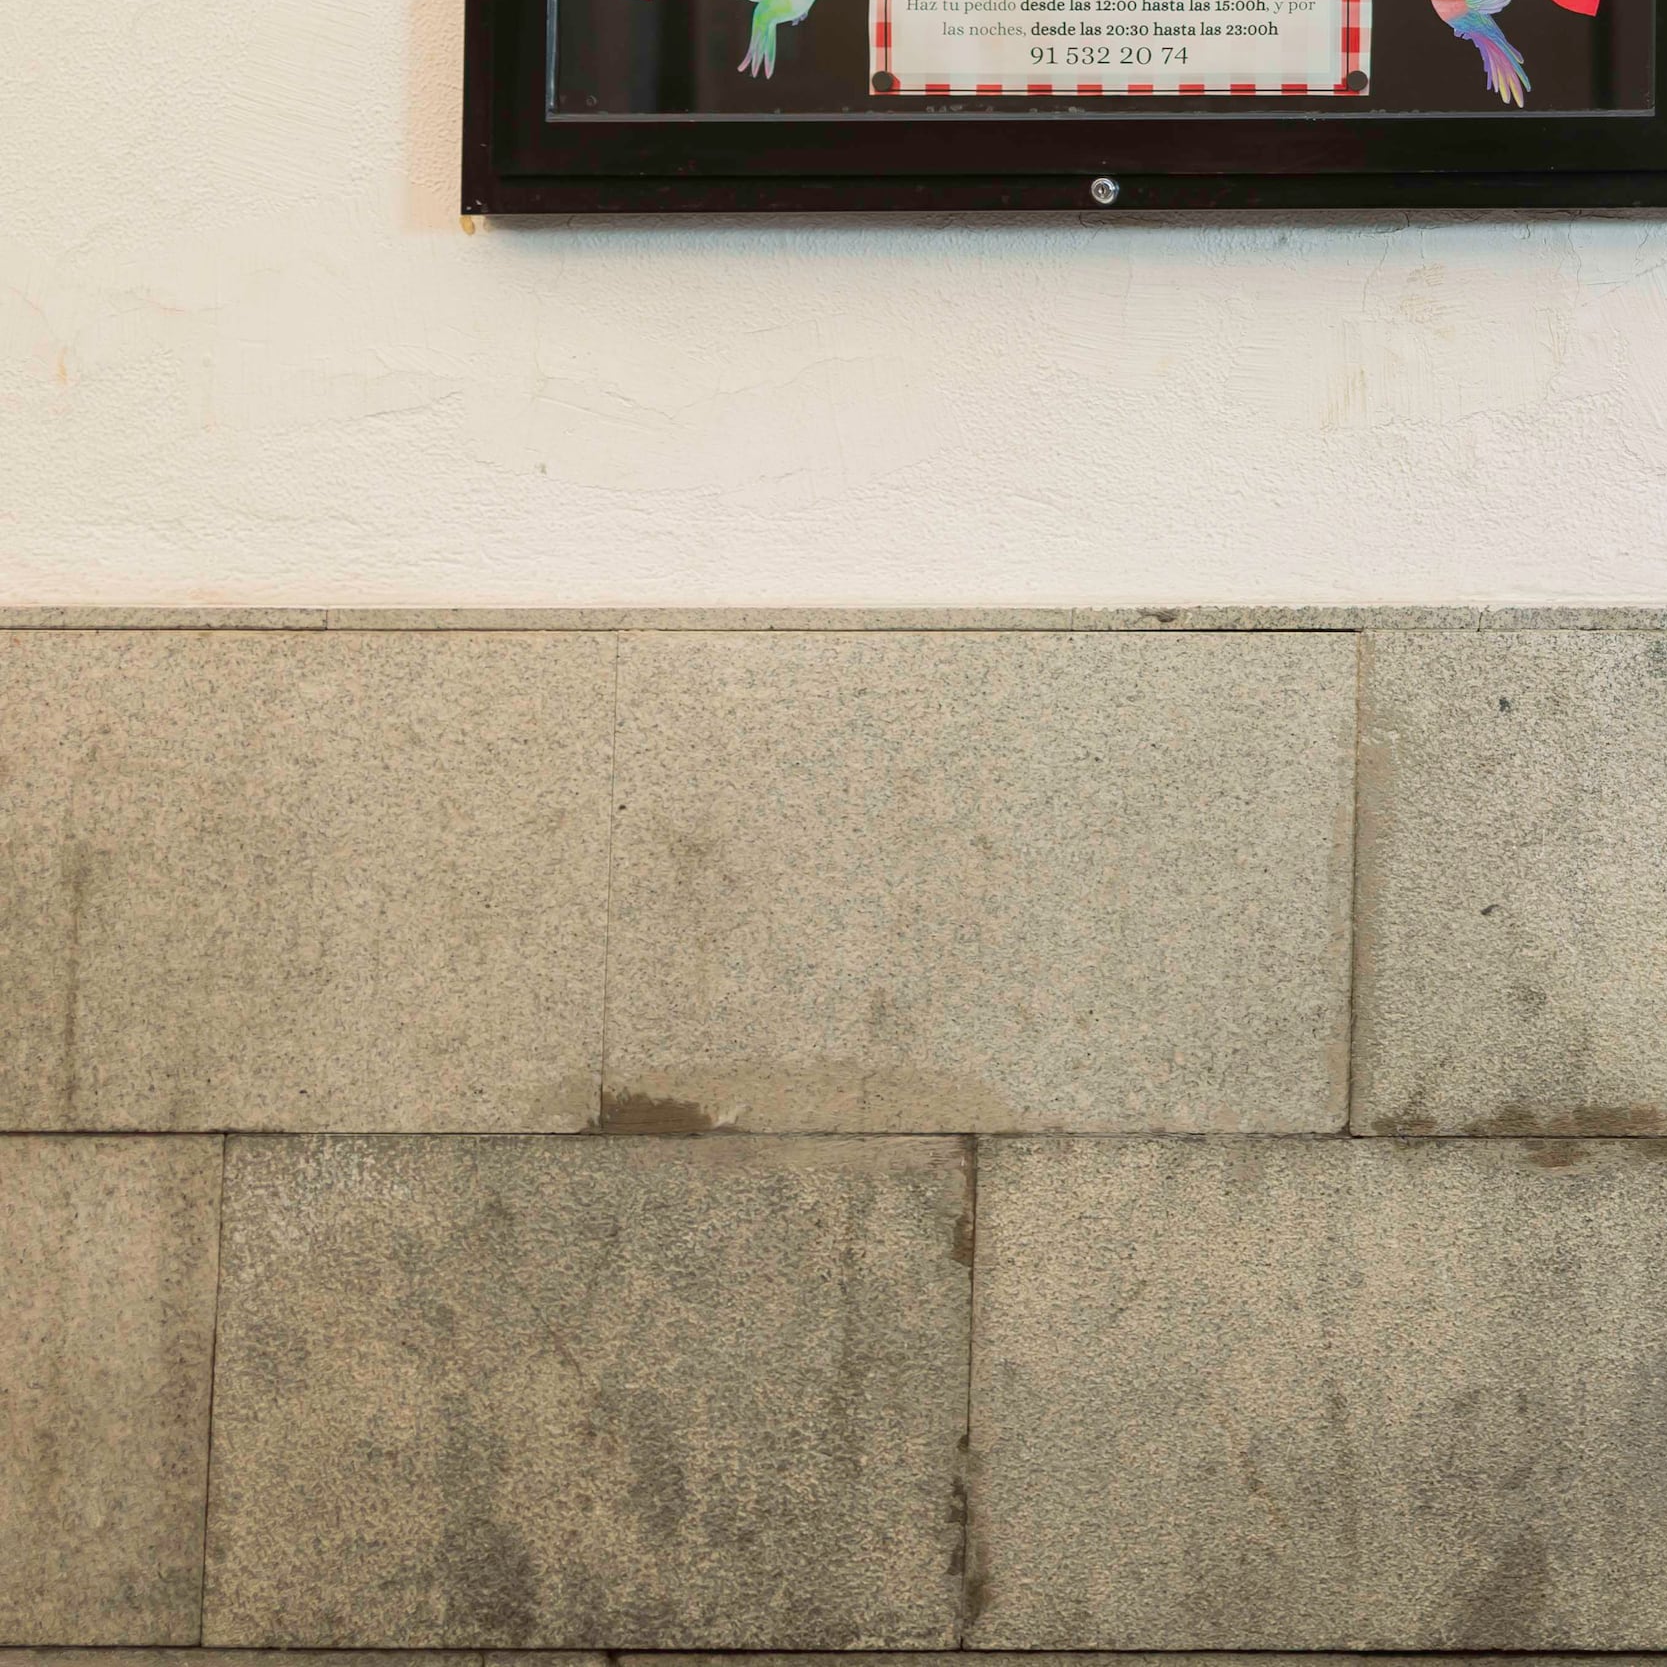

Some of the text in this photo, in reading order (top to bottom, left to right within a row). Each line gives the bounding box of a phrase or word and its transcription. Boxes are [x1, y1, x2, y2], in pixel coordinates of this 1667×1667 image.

[942, 0, 960, 12] tu
[1095, 0, 1138, 12] 12:00
[1274, 1, 1285, 15] y
[1287, 0, 1316, 15] por
[942, 21, 1279, 38] las noches, desde las 20:30 hasta las 23:00h
[1030, 46, 1189, 67] 91 532 20 74
